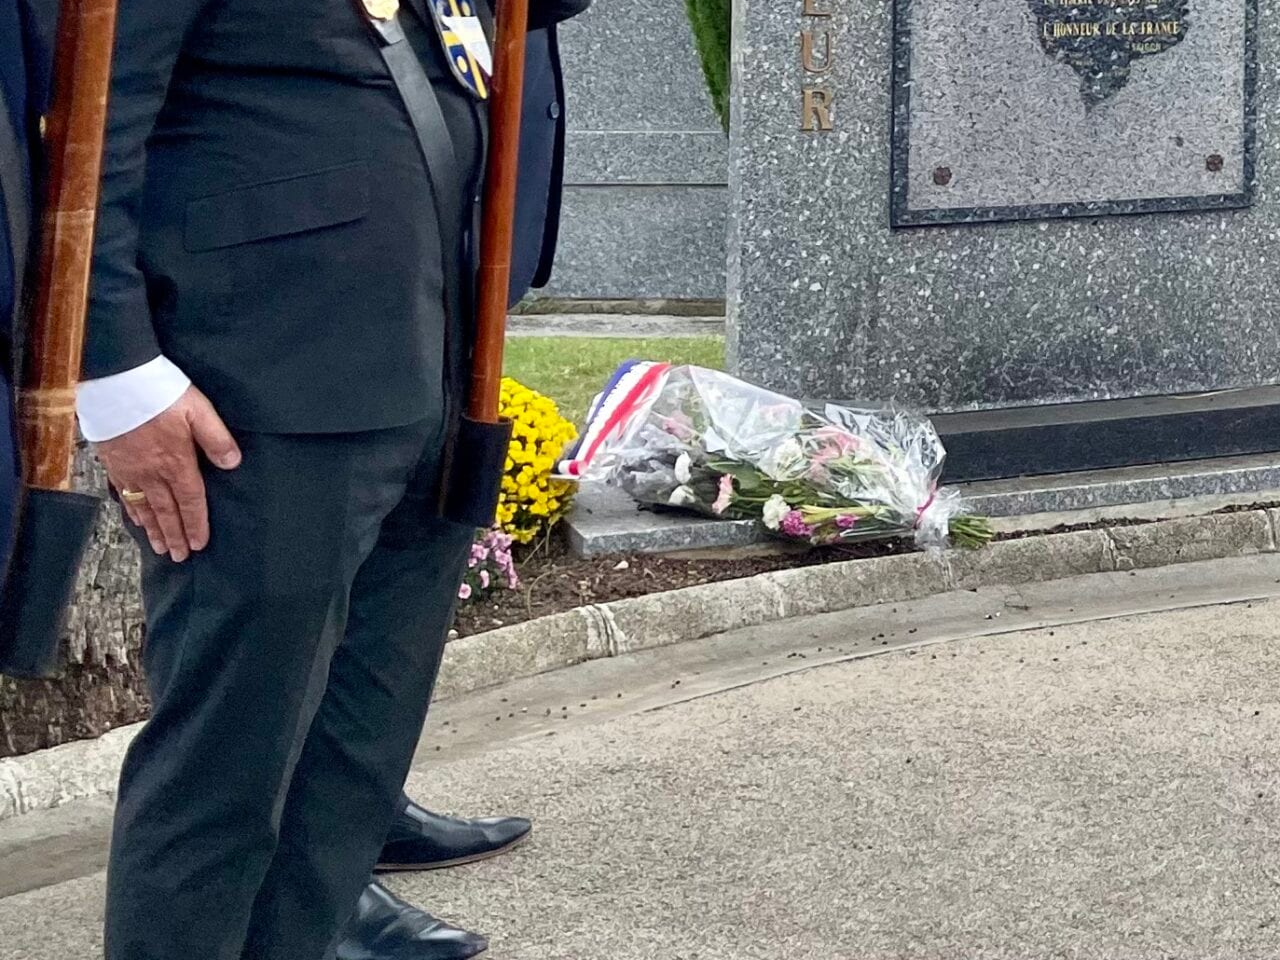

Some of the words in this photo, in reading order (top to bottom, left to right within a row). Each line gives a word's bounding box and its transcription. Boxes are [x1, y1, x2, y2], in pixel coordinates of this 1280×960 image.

[1105, 22, 1117, 35] DE
[1122, 22, 1136, 35] LA
[1140, 21, 1179, 35] FRANCE
